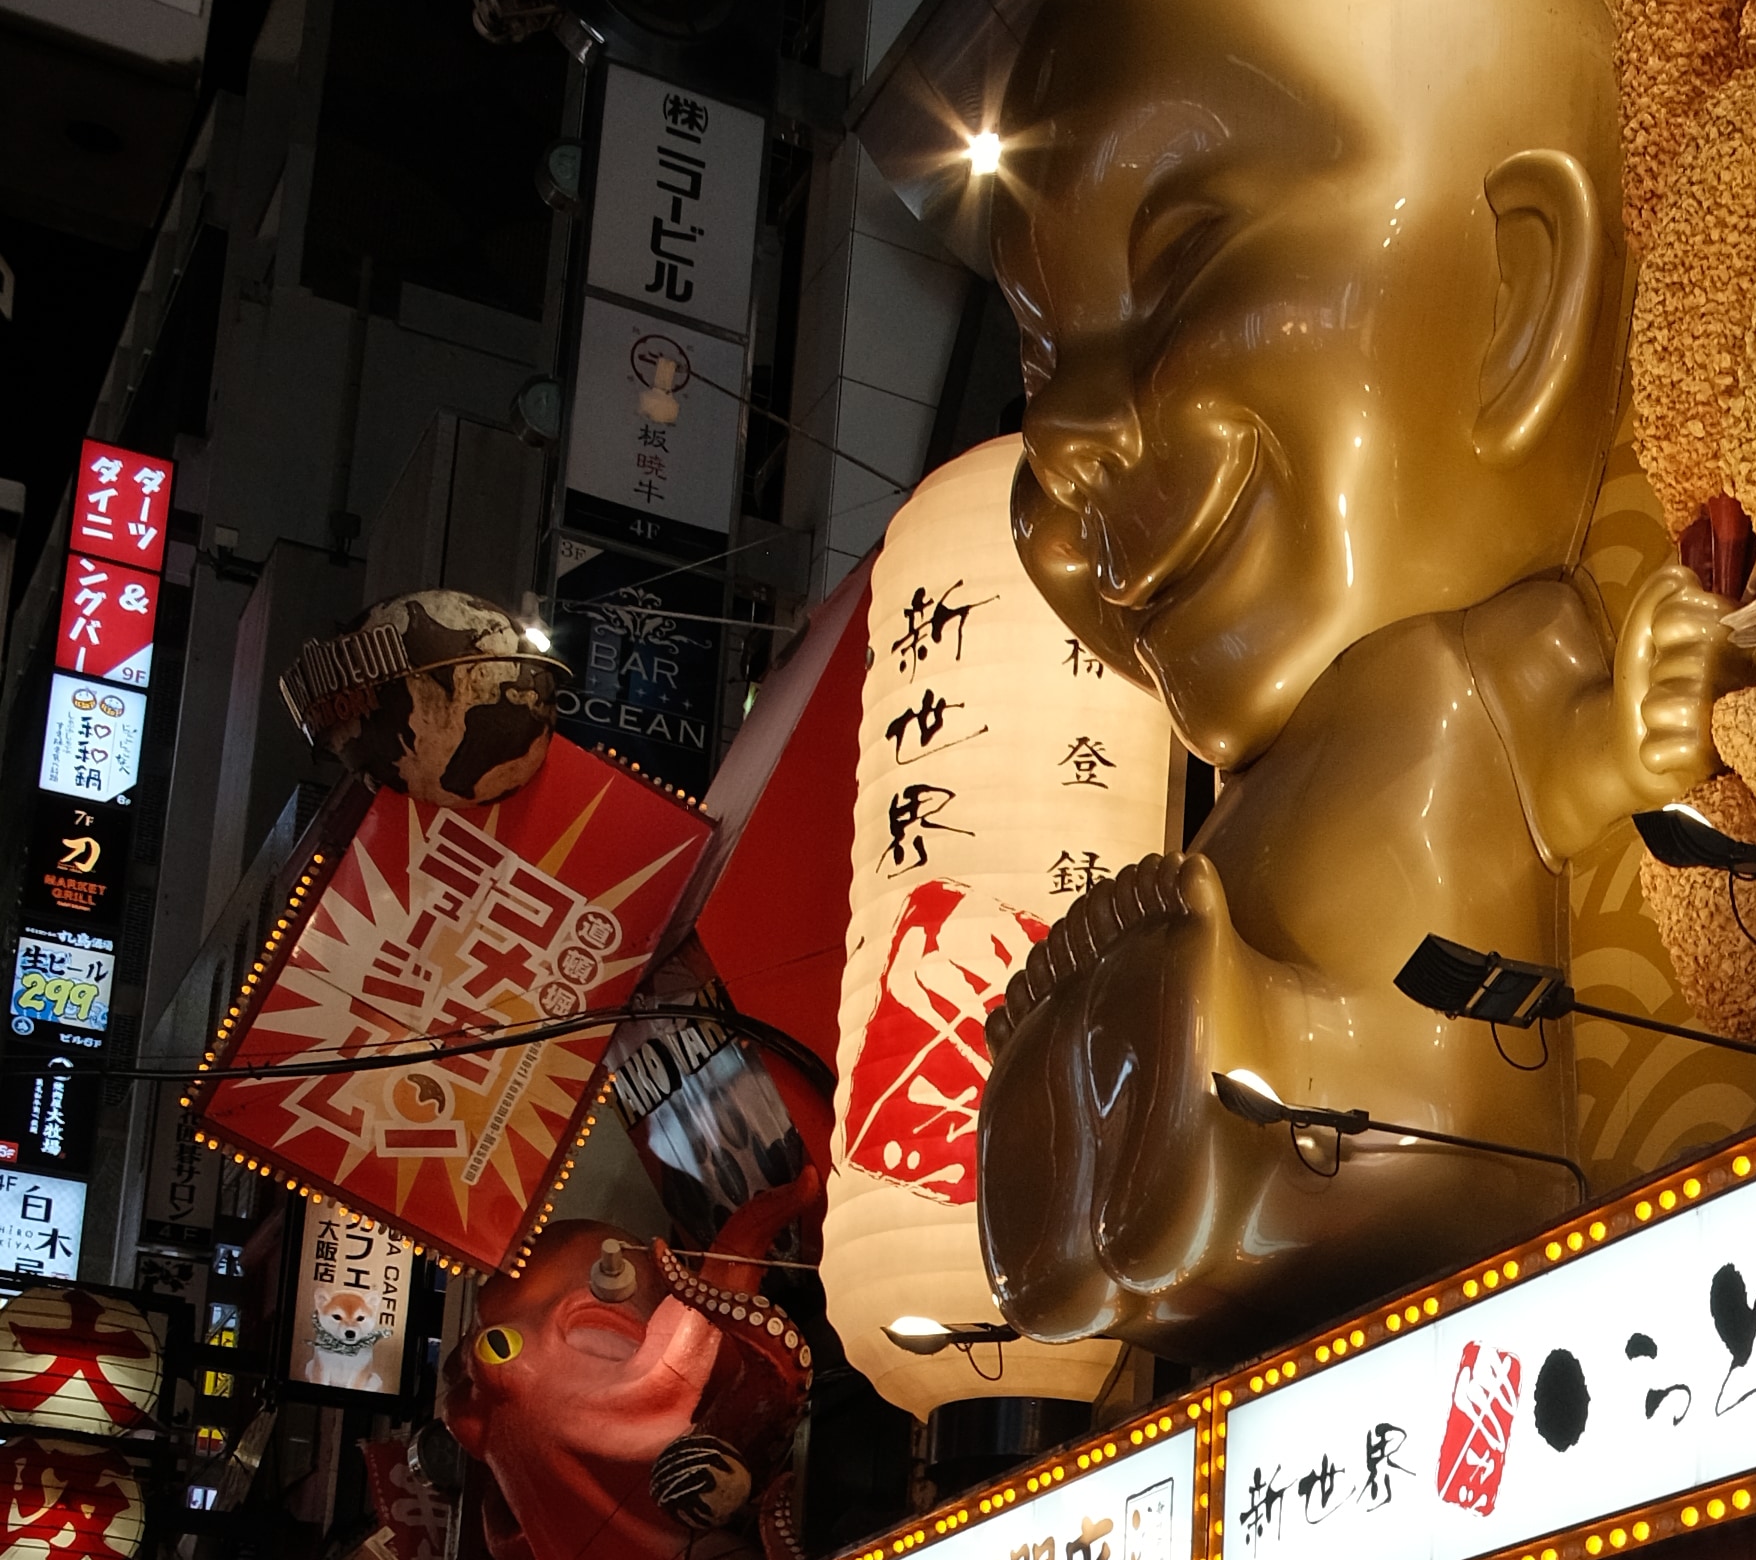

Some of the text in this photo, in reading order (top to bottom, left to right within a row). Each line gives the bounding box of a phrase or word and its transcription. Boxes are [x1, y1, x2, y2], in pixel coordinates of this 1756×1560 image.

[119, 466, 166, 616] ダーツ &
[561, 540, 587, 561] 3F
[629, 519, 662, 540] 4F
[122, 666, 147, 685] 9F
[592, 640, 680, 691] BAR
[555, 689, 706, 750] OCEAN
[876, 582, 999, 880] 新世界
[74, 810, 96, 828] 7F
[21, 944, 109, 982] 生ビール
[539, 908, 616, 1018] 道頓堀
[18, 971, 99, 1022] 299
[314, 1219, 340, 1284] 大阪店
[379, 1265, 400, 1327] CAFE
[1240, 1422, 1417, 1559] 新世界
